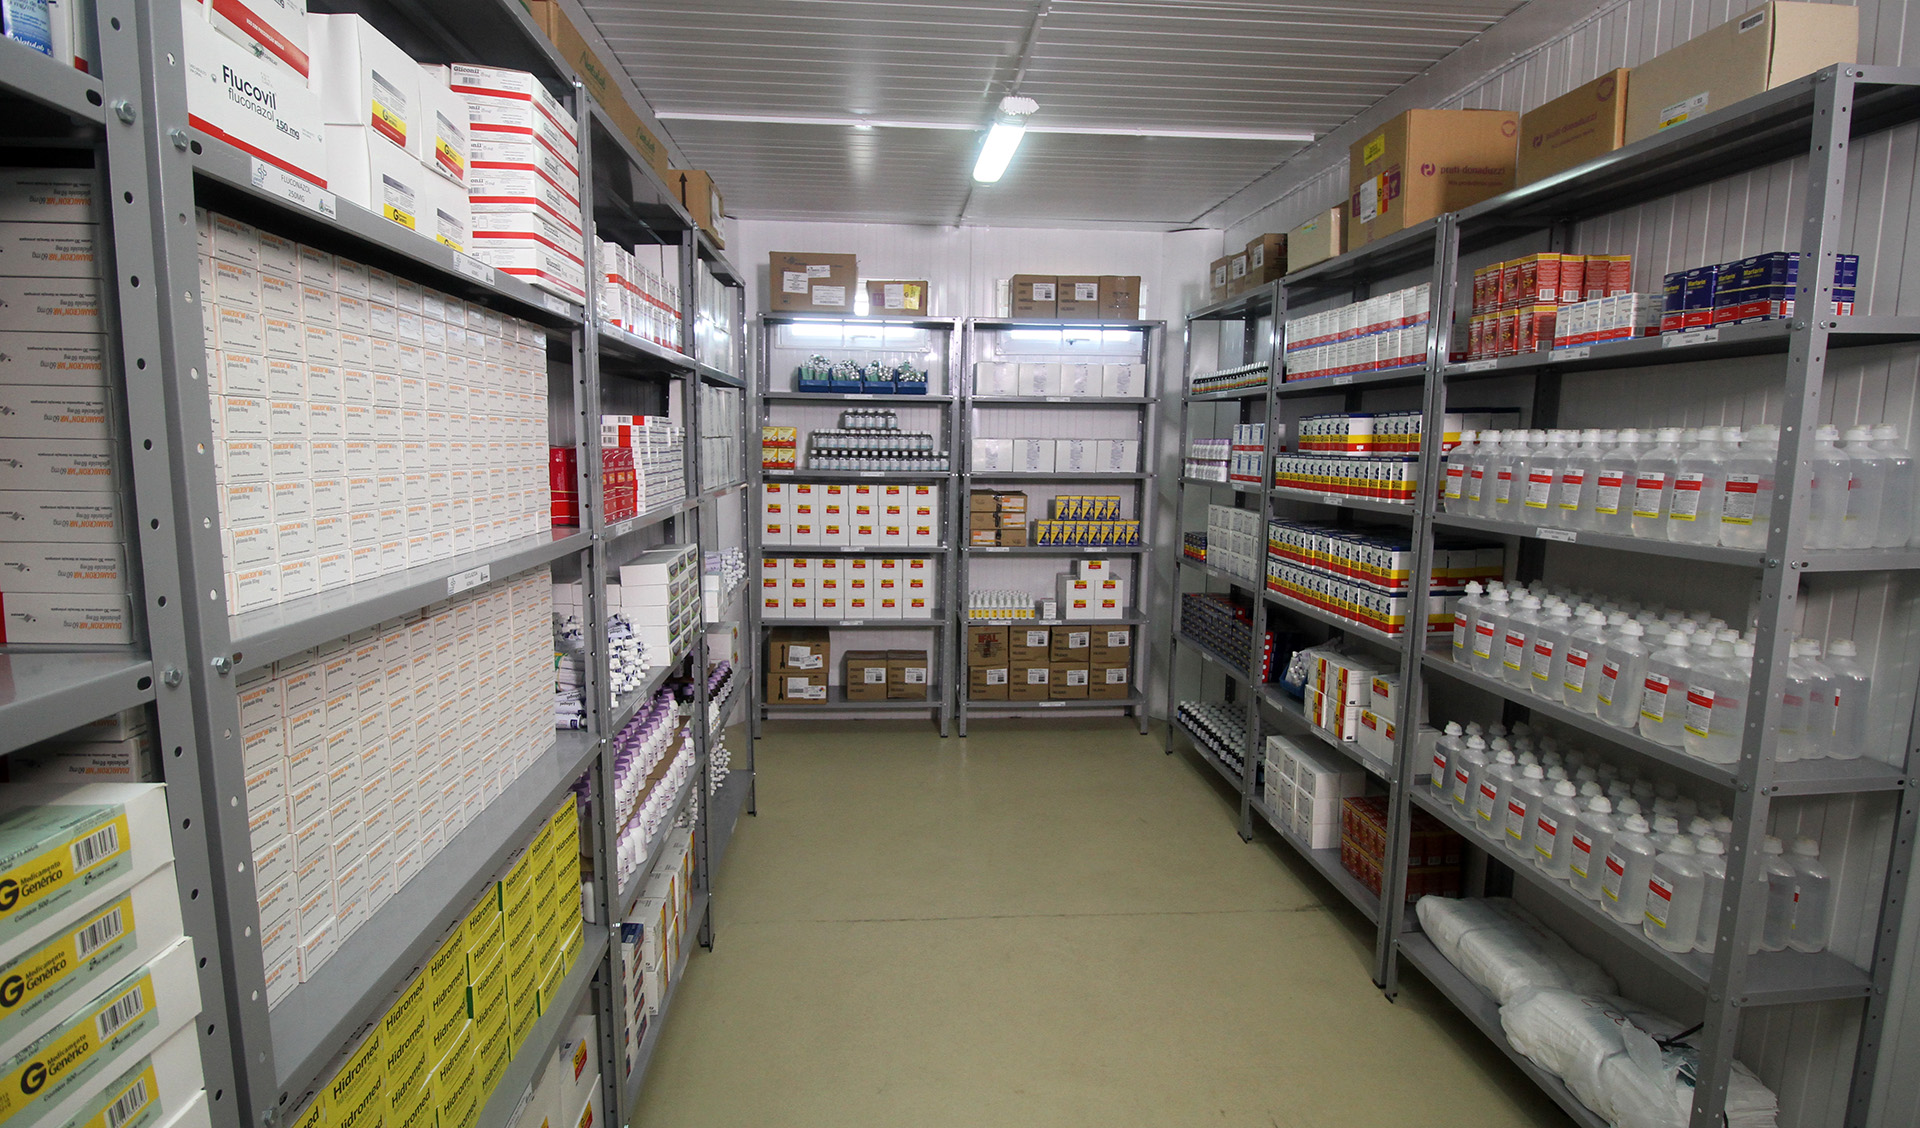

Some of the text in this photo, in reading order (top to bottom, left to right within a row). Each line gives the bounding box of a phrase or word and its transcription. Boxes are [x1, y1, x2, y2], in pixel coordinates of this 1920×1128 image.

[222, 64, 277, 110] Flucovil
[228, 87, 275, 122] fluconazol
[276, 118, 289, 133] 150
[289, 125, 300, 140] mg
[20, 860, 61, 885] Medicamento
[21, 868, 63, 899] Genérico
[0, 878, 20, 912] G
[25, 951, 65, 978] Medicamento
[431, 931, 463, 976] Hidromed
[0, 975, 25, 1008] G
[26, 958, 67, 991] Genérico
[433, 965, 465, 1011] Hidromed
[387, 978, 425, 1031] Hidromed
[434, 997, 466, 1046] Hidromed
[47, 1034, 87, 1065] Medicamento
[48, 1042, 89, 1077] Genérico
[387, 1015, 425, 1070] Hidromed
[440, 1031, 471, 1081] Hidromed
[20, 1061, 47, 1095] G
[333, 1035, 380, 1100] Hidromed
[392, 1052, 426, 1108] Hidromed
[341, 1075, 381, 1128] idromed
[400, 1088, 431, 1128] dromed
[444, 1064, 475, 1115] Hidromed
